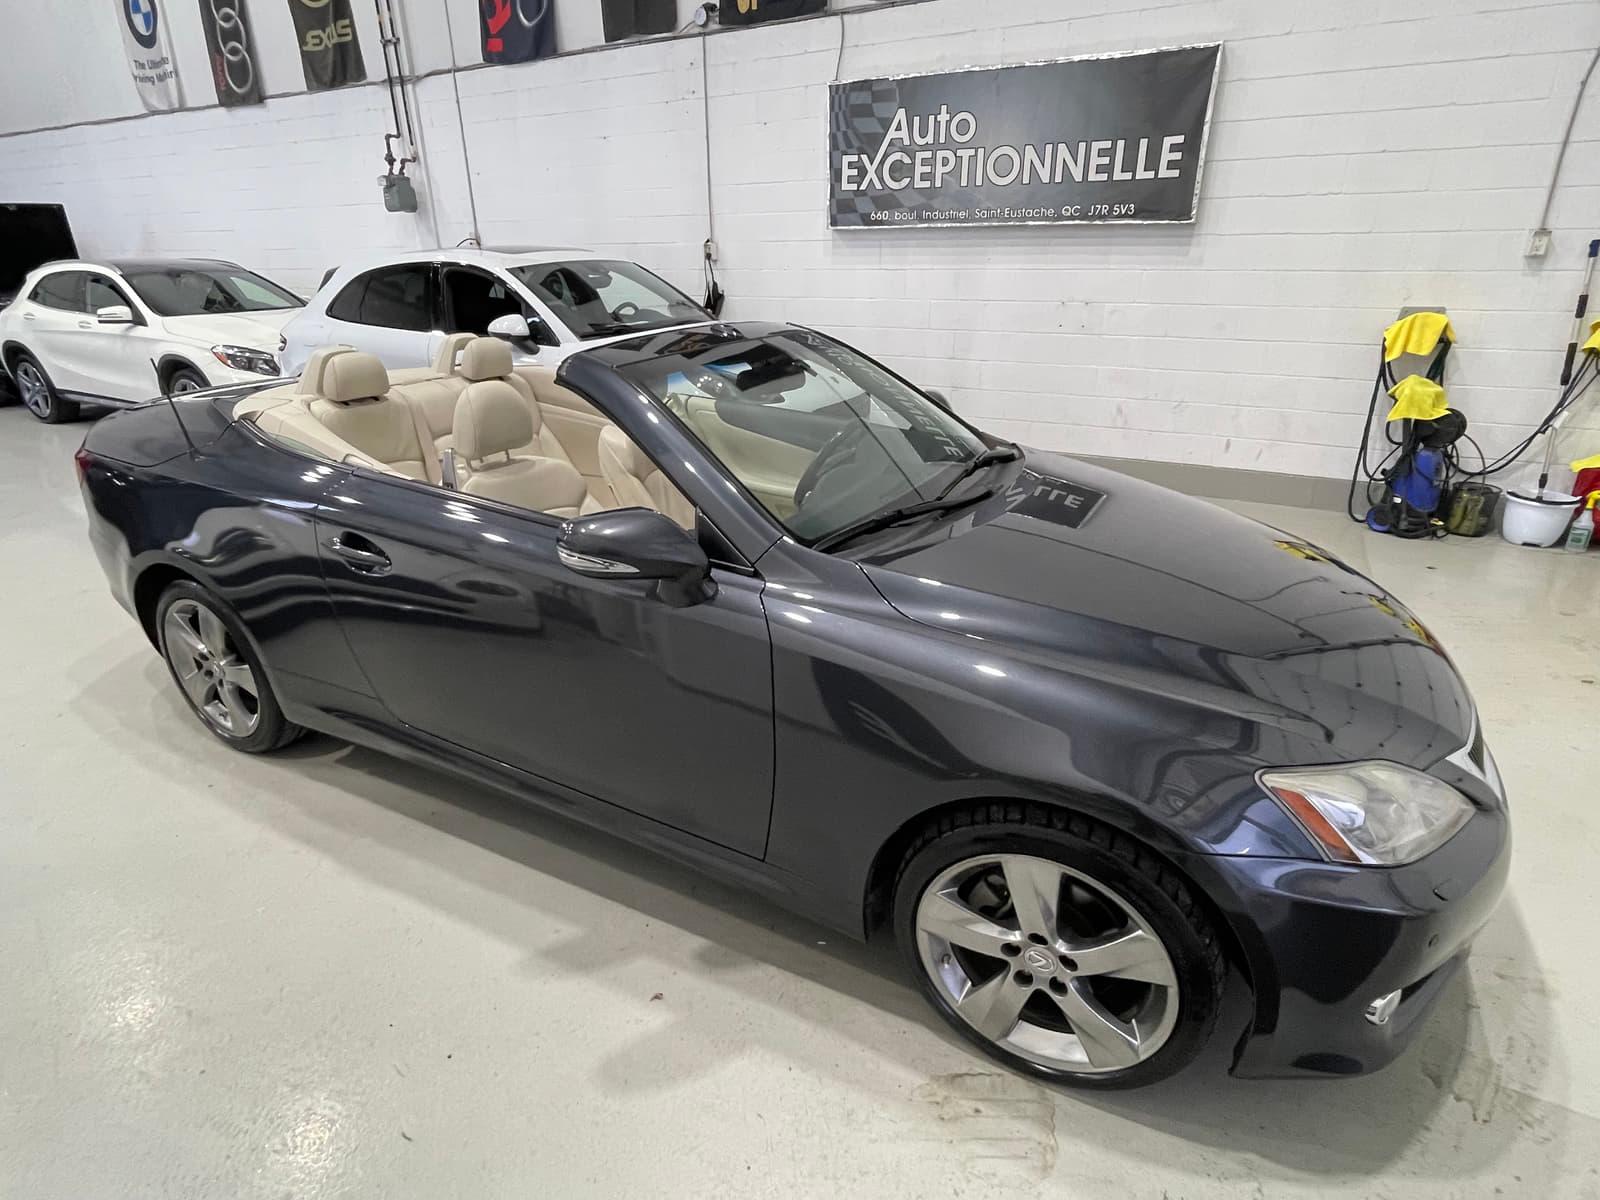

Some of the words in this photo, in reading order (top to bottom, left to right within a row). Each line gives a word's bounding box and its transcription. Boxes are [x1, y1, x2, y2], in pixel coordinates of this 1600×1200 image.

[885, 104, 977, 146] Auto
[841, 134, 1185, 192] EXCEPTIONNELLE
[894, 210, 919, 221] boul.
[975, 207, 1058, 219] Saint-Eustache,
[1061, 205, 1081, 217] QC
[1087, 204, 1109, 216] J7R
[1112, 203, 1135, 216] 5V3
